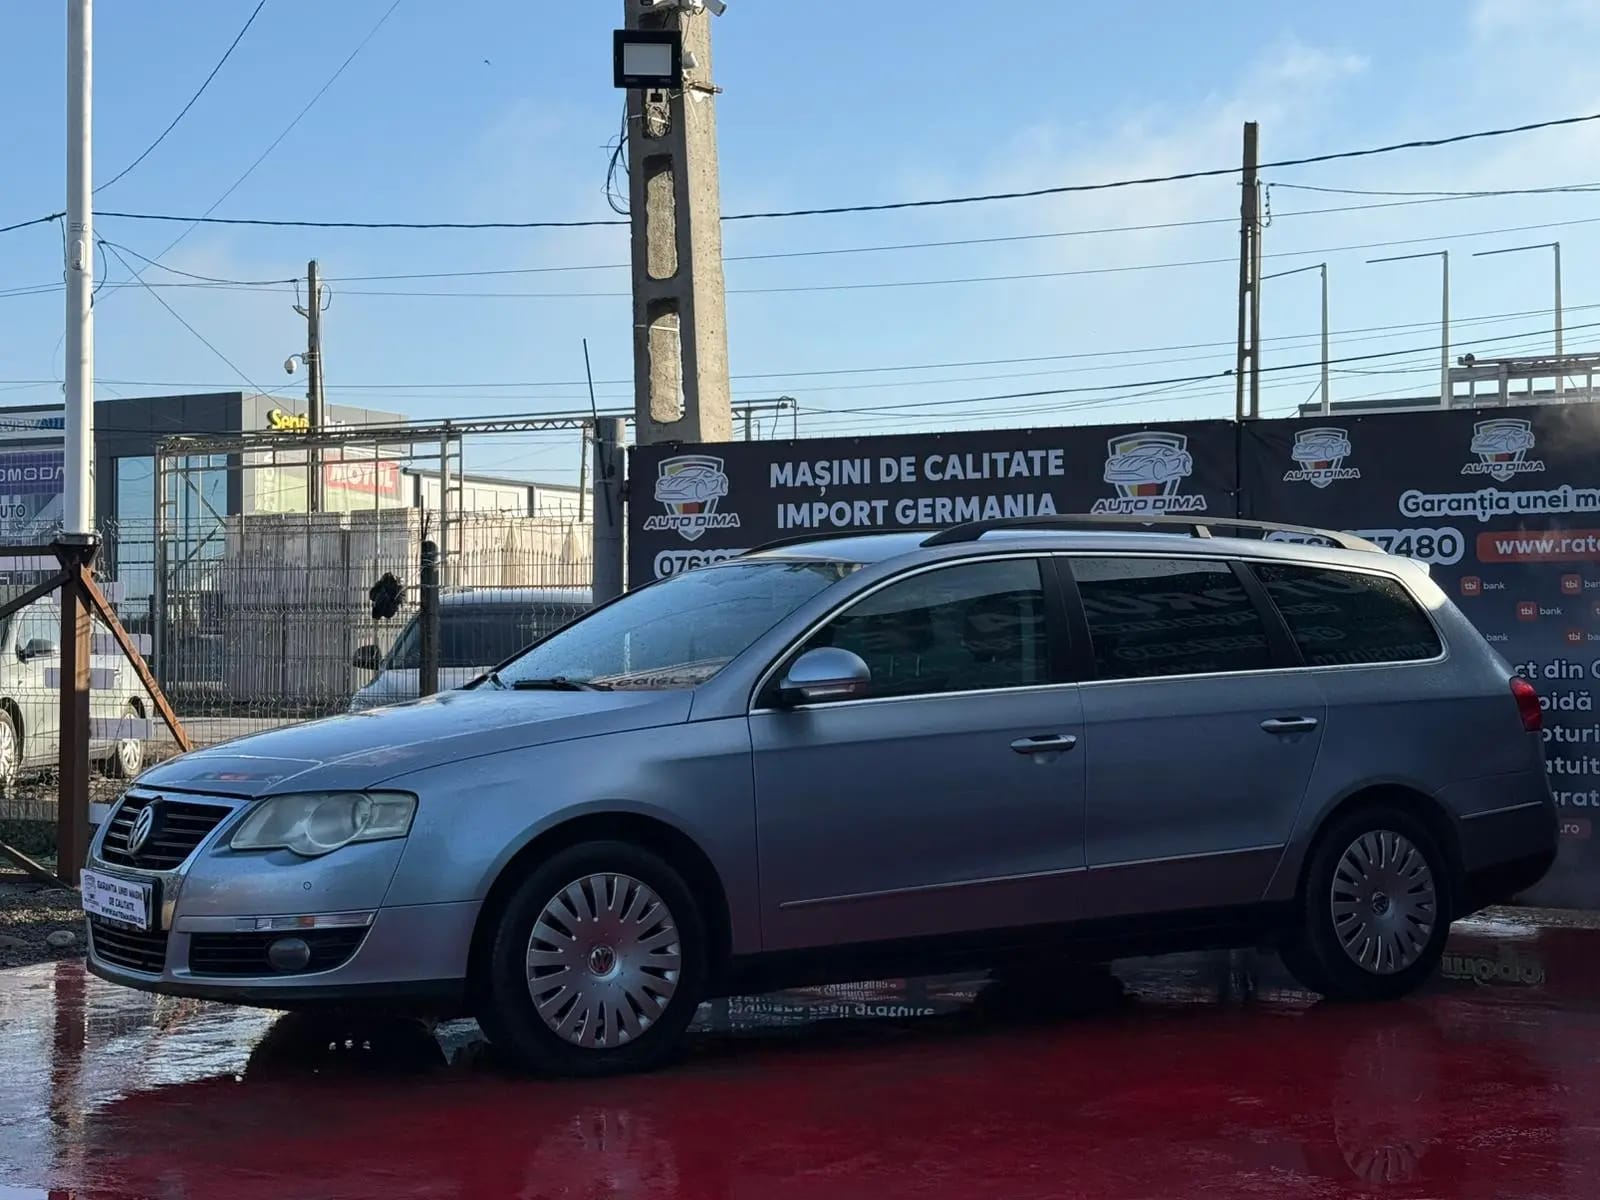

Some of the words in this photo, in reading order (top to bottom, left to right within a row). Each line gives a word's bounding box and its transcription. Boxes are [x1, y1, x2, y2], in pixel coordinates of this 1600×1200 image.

[1463, 463, 1502, 472] AUTO
[1506, 462, 1543, 471] DIMA
[770, 458, 870, 496] MAȘINI
[880, 457, 916, 483] DE
[924, 449, 1065, 481] CALITATE
[1285, 470, 1321, 479] AUTO
[1324, 469, 1358, 478] DIMA
[1093, 499, 1147, 512] AUTO
[1152, 497, 1205, 511] DIMA
[1403, 491, 1510, 517] Garanția
[1517, 490, 1568, 508] unei
[777, 499, 888, 529] IMPORT
[894, 493, 1056, 525] GERMANIA
[646, 516, 691, 528] AUTO
[695, 515, 738, 527] DIMA
[1464, 582, 1477, 590] tbi
[1483, 581, 1505, 590] bank
[1565, 580, 1578, 589] tbi
[1521, 607, 1534, 615] tbi
[1539, 607, 1562, 616] bank
[1486, 632, 1508, 642] bank
[1568, 631, 1581, 641] tbi
[1544, 660, 1583, 678] din
